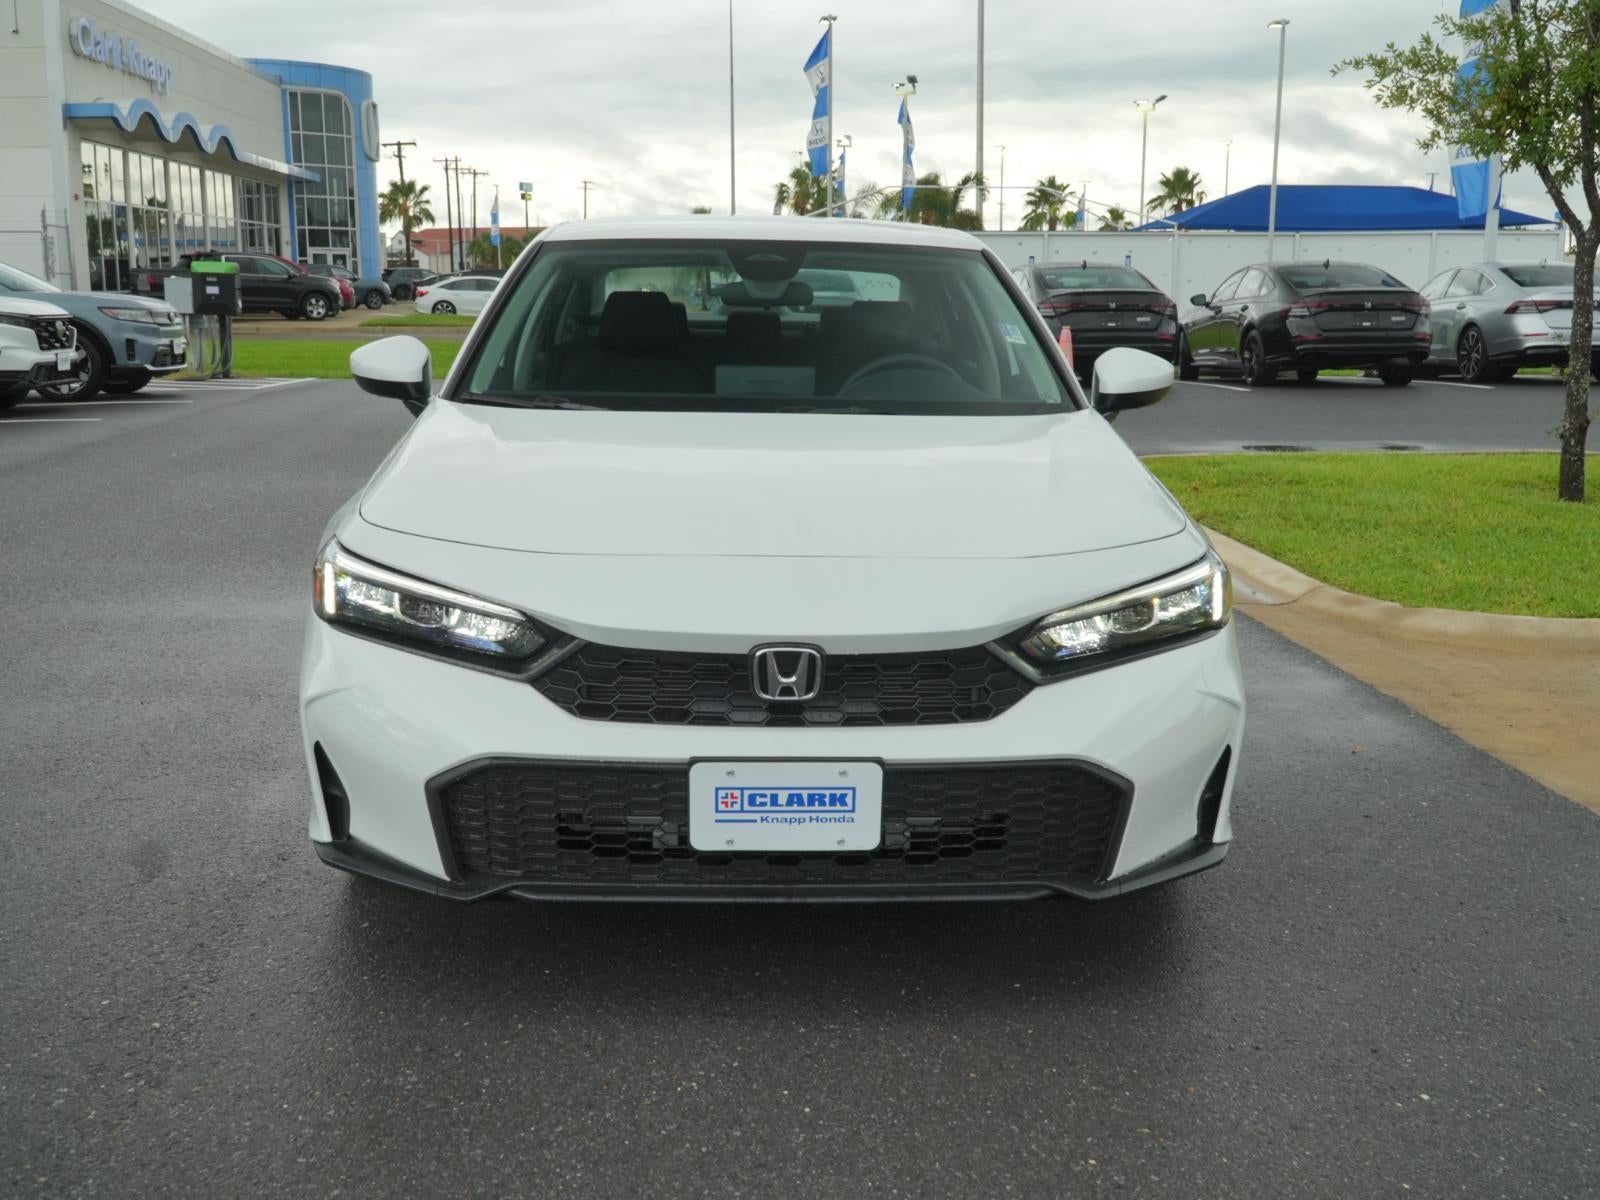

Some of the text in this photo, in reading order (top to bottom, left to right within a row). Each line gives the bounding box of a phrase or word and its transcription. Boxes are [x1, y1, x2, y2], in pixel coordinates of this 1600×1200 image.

[748, 793, 849, 807] CLARK
[760, 815, 855, 825] Knapp Honda
